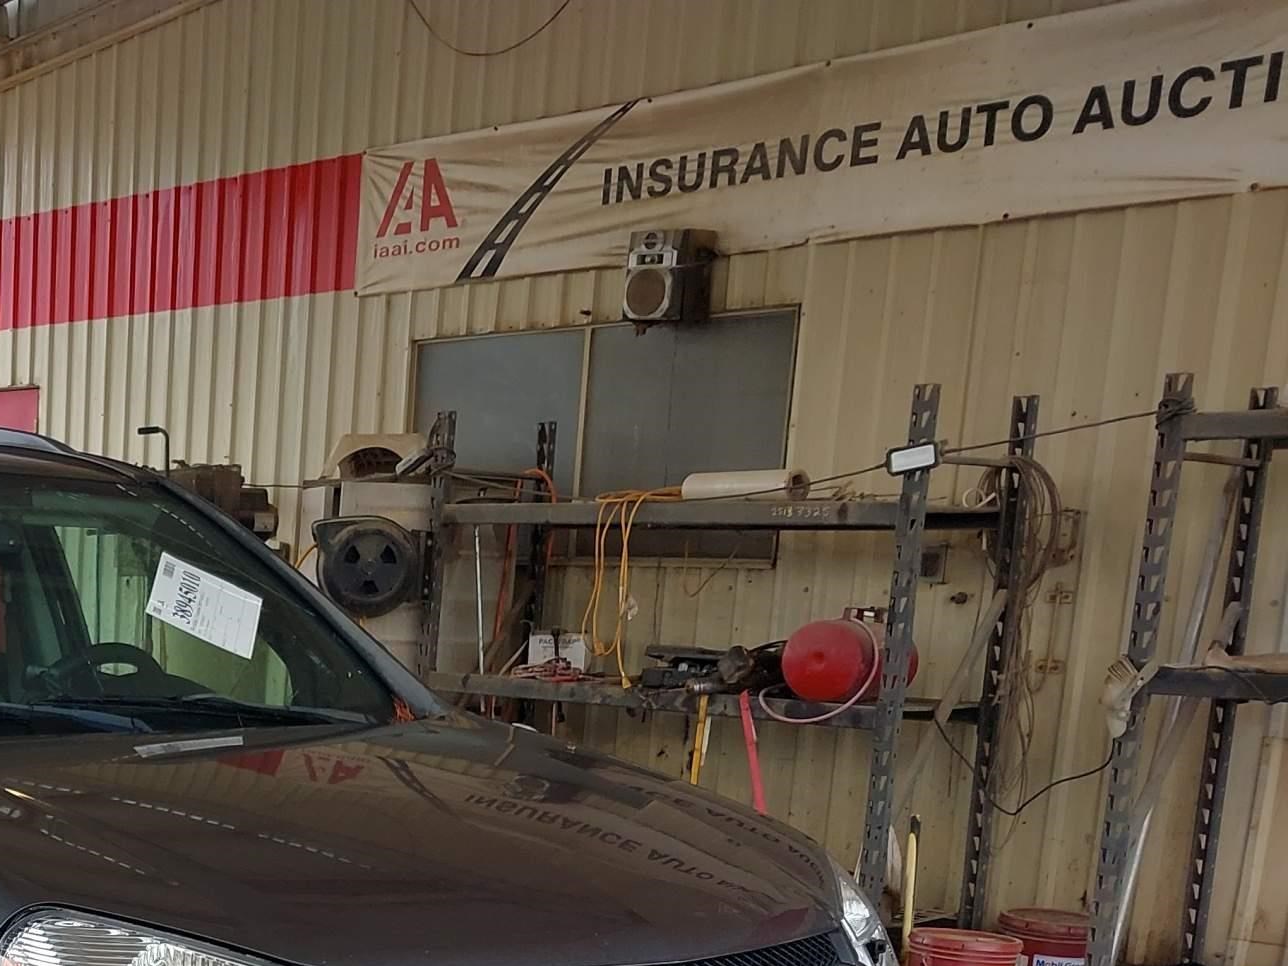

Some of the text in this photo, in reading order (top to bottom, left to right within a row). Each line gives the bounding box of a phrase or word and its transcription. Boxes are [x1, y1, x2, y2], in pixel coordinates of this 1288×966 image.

[601, 51, 1285, 205] INSURANCE AUTO AUCTI
[373, 237, 460, 259] iaai.com
[173, 570, 201, 625] 38945010
